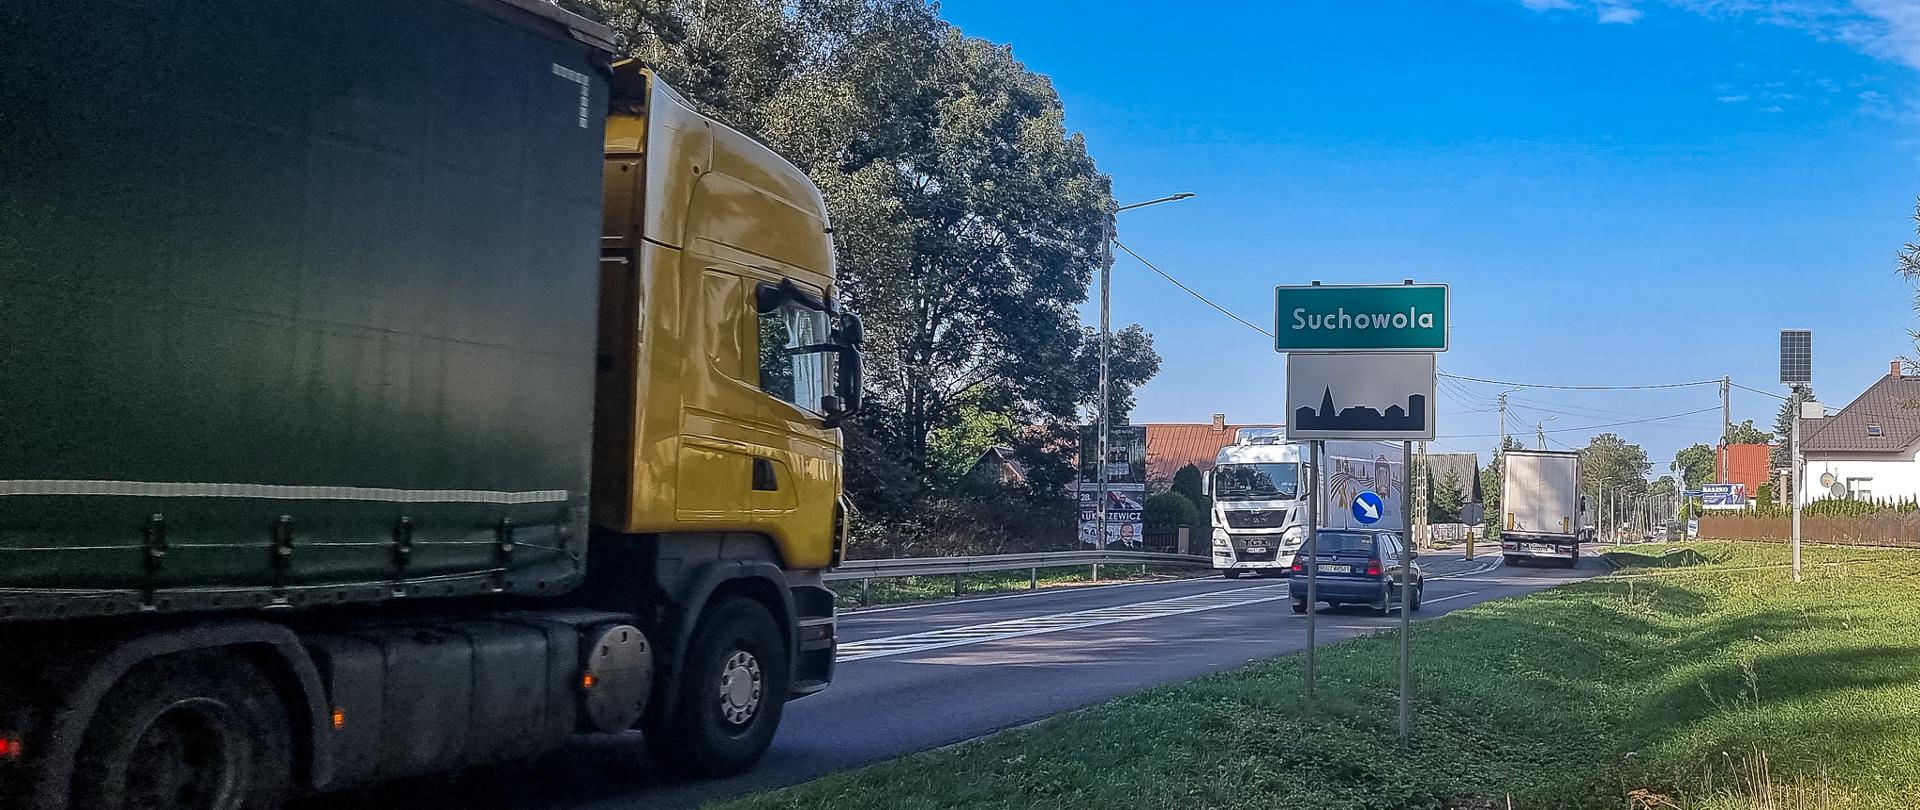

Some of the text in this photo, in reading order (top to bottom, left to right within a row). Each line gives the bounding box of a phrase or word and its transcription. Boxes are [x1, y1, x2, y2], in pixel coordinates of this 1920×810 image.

[1291, 306, 1434, 330] Suchowola
[1081, 511, 1141, 521] ŁUKZEWICZ
[1244, 538, 1268, 546] TGX
